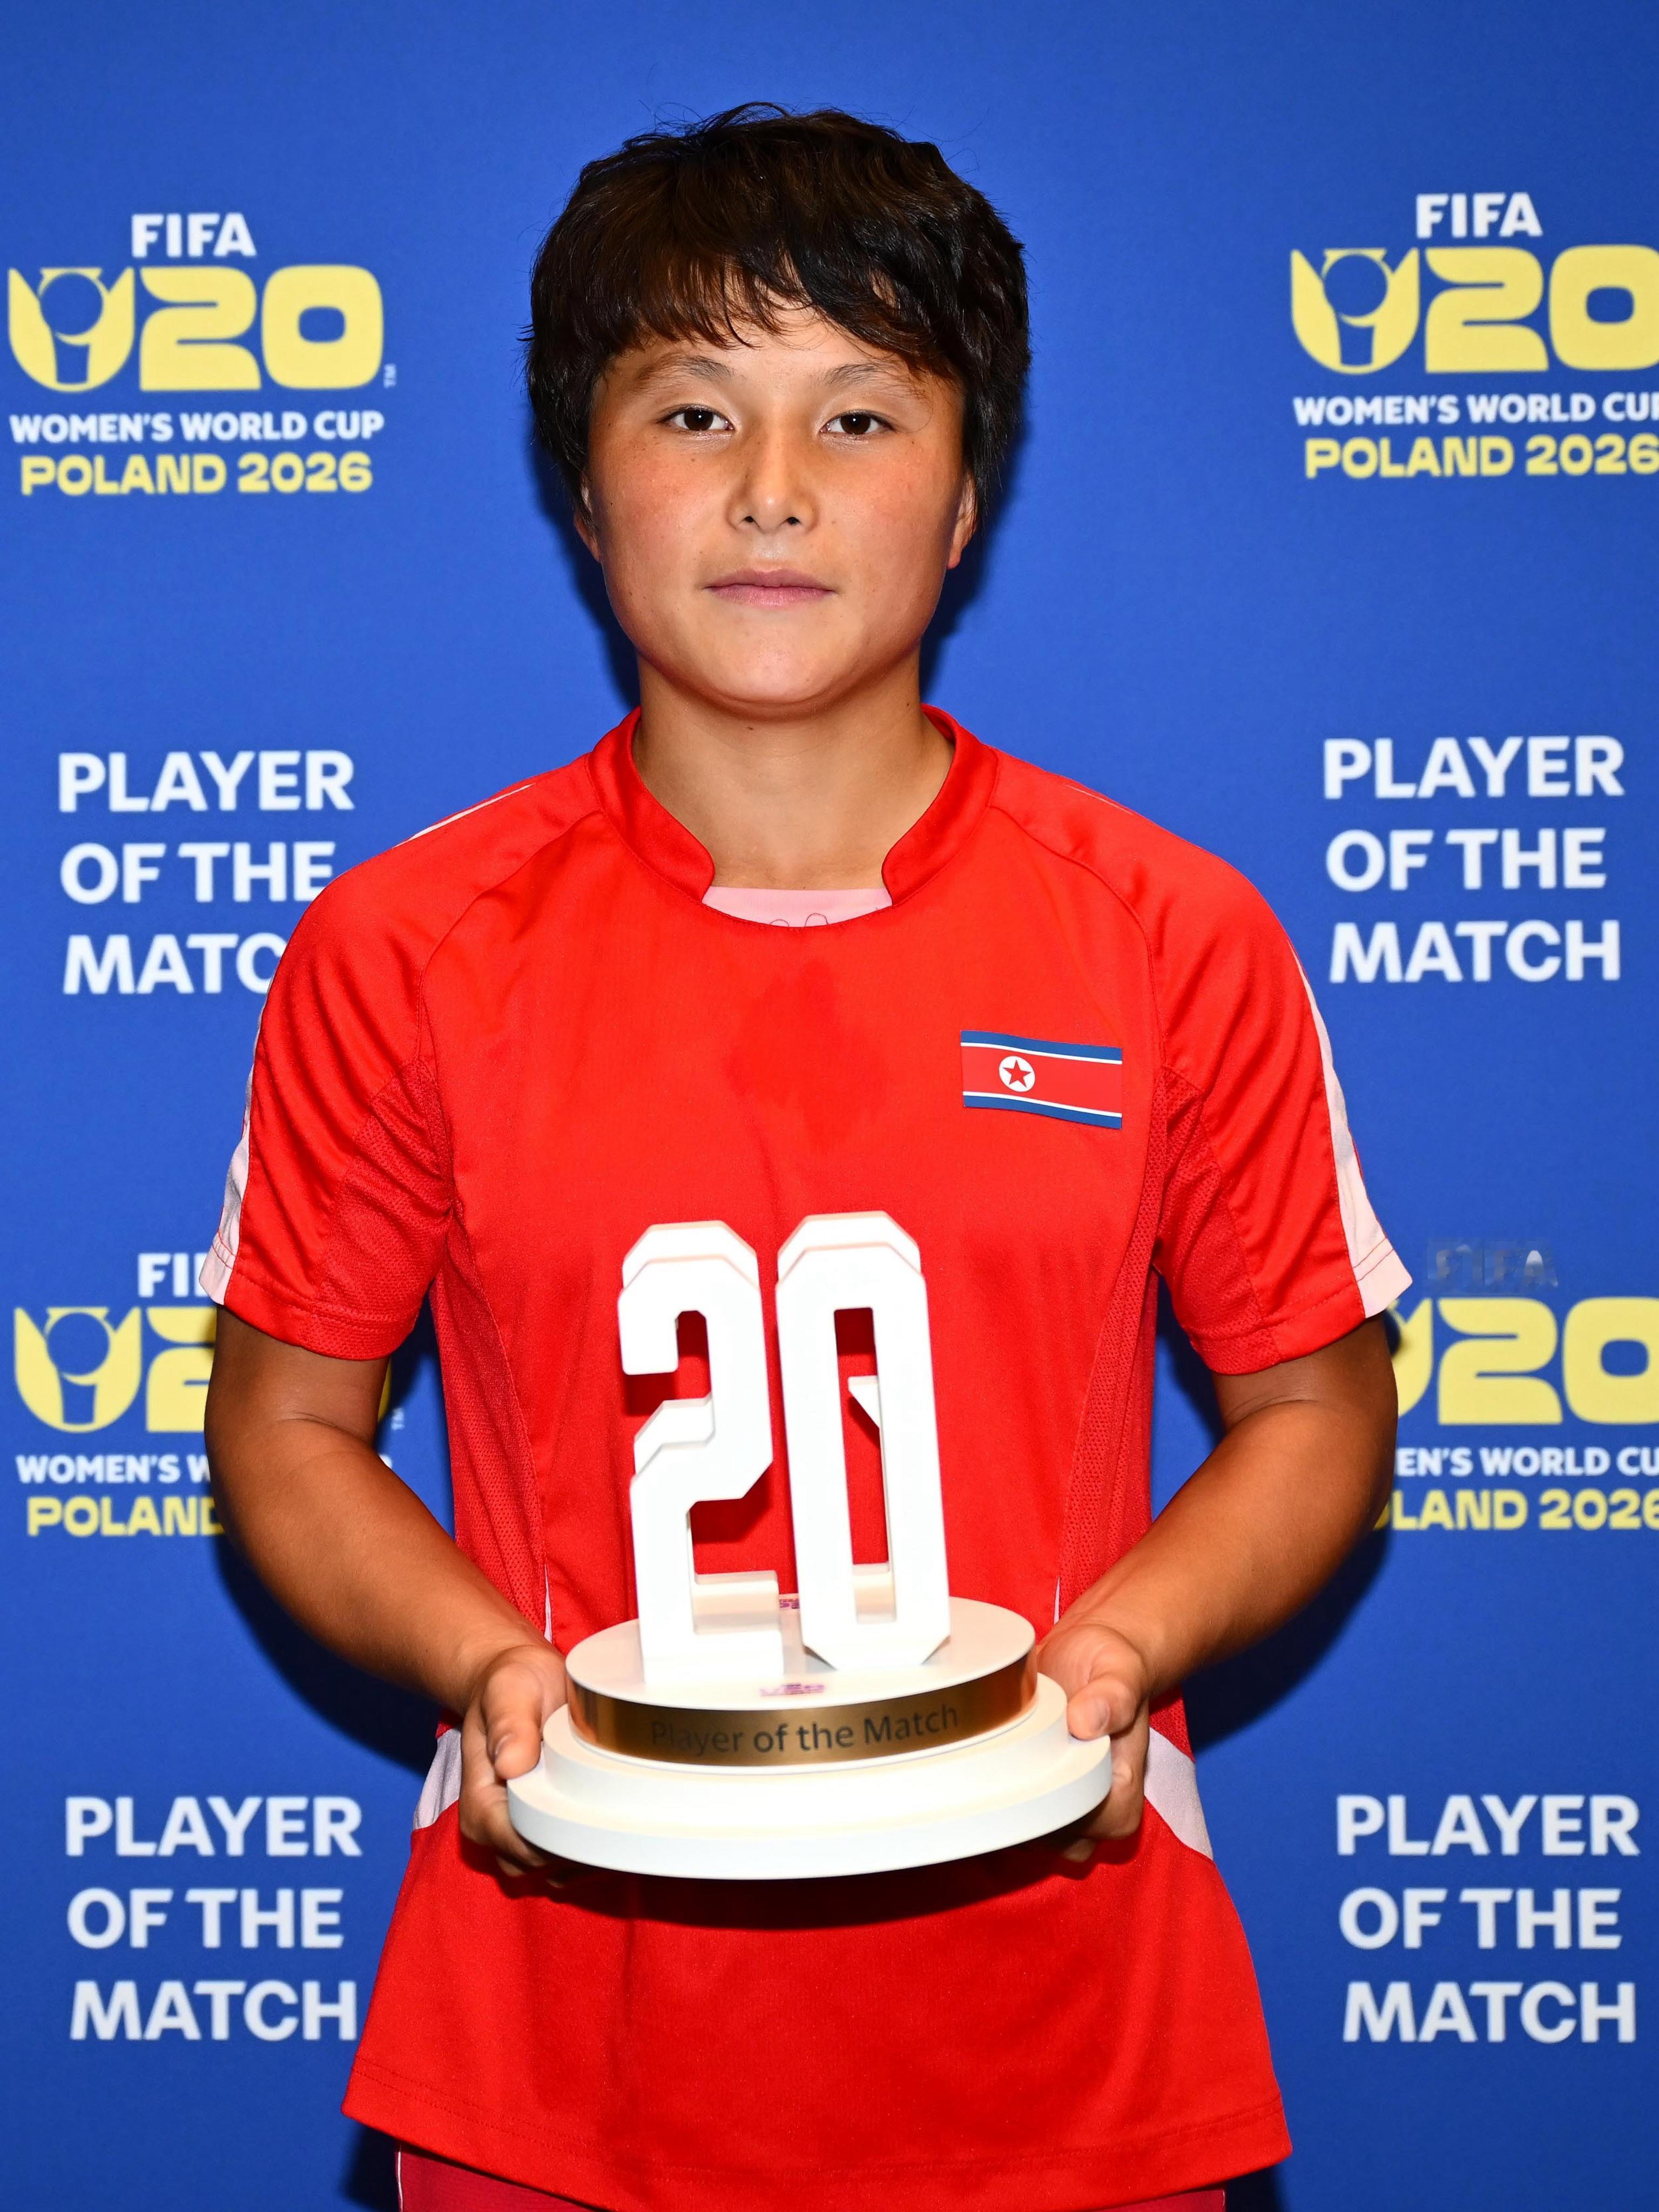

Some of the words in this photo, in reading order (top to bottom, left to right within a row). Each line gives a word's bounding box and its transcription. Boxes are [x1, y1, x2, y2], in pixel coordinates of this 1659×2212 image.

[131, 213, 257, 258] FIFA
[1416, 193, 1543, 238] FIFA
[9, 413, 174, 443] WOMEN'S
[179, 412, 307, 441] WORLD
[313, 410, 385, 440] CUP
[1293, 395, 1459, 426] WOMEN'S
[1466, 394, 1596, 424] WORLD
[21, 454, 227, 496] POLAND
[238, 451, 373, 493] 2026
[1305, 435, 1514, 479] POLAND
[1526, 434, 1659, 475] 2026
[59, 750, 354, 813] PLAYER
[1324, 736, 1624, 799] PLAYER
[60, 842, 166, 905] OF
[178, 841, 335, 902] THE
[1326, 829, 1434, 892] OF
[1446, 827, 1607, 890] THE
[63, 933, 288, 995] MATC
[1330, 920, 1620, 983] MATCH
[138, 1252, 210, 1297] FI
[16, 1454, 181, 1484] WOMEN'S
[617, 1211, 950, 1686] 20
[1395, 1447, 1473, 1476] EN'S
[1479, 1447, 1610, 1476] WORLD
[1617, 1446, 1659, 1476] CU
[1373, 1489, 1528, 1530] LAND
[651, 1719, 744, 1755] Player
[753, 1723, 788, 1753] of
[797, 1722, 855, 1751] the
[864, 1704, 958, 1744] Match
[66, 1796, 362, 1856] PLAYER
[1337, 1795, 1640, 1856] PLAYER
[68, 1887, 173, 1949] OF
[185, 1889, 344, 1948] THE
[1339, 1887, 1447, 1950] OF
[1460, 1889, 1622, 1950] THE
[71, 1980, 356, 2041] MATCH
[1343, 1981, 1636, 2044] MATCH
